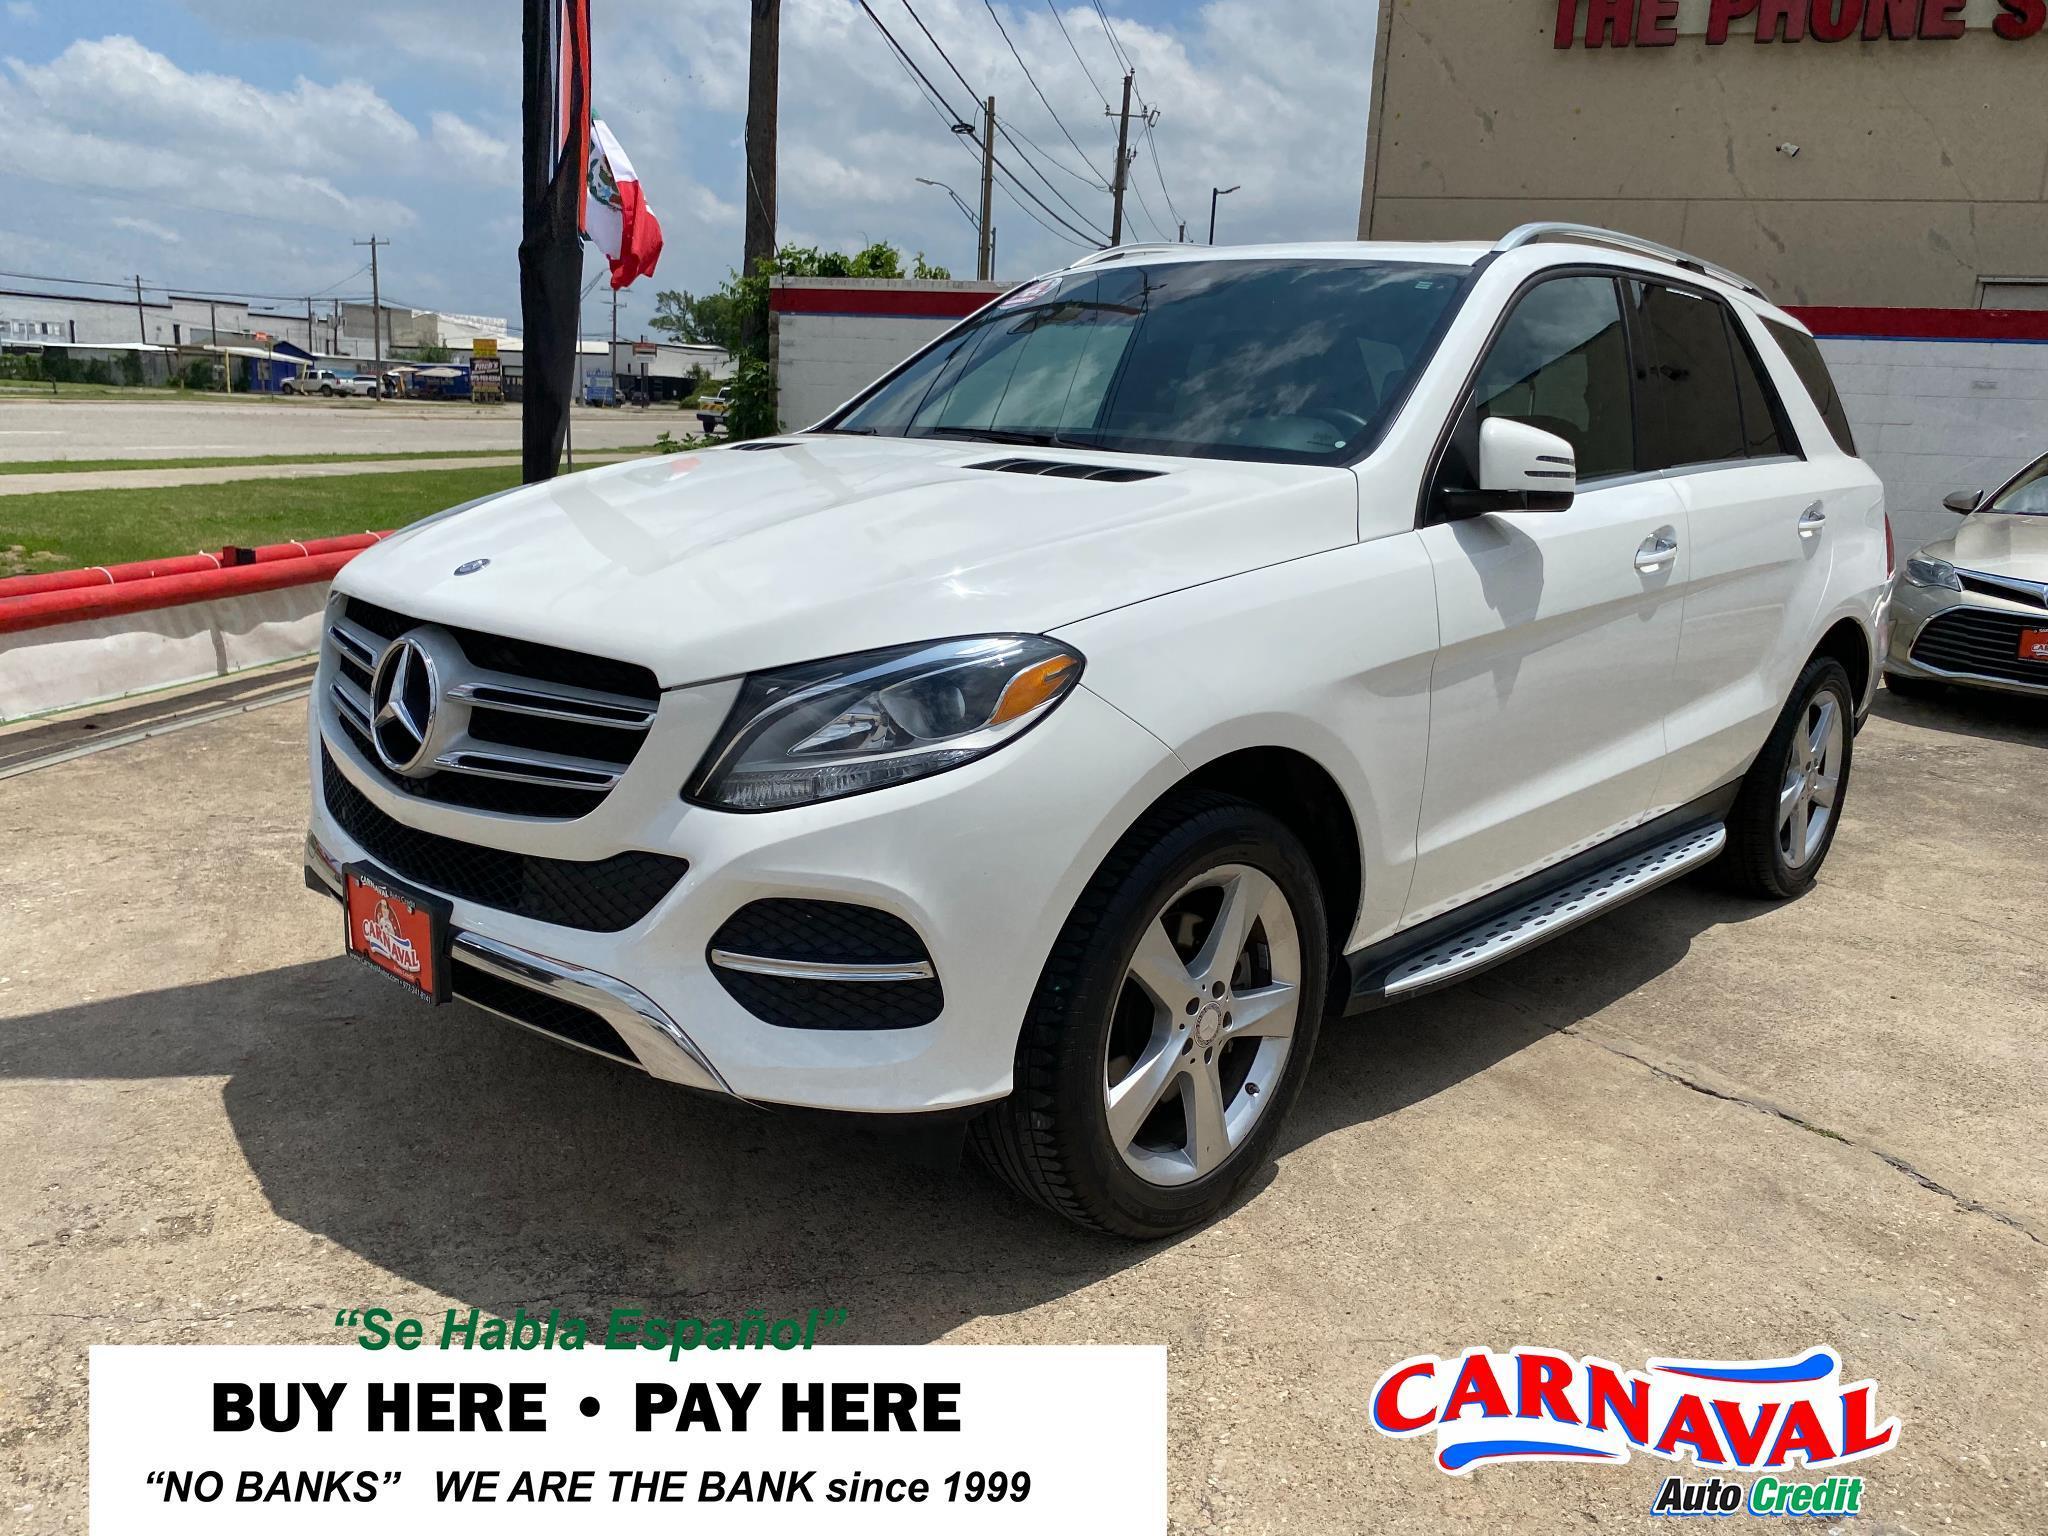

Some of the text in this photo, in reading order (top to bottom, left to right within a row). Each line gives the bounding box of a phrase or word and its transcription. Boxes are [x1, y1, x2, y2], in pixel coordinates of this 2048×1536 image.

[1554, 0, 1679, 49] THE
[1705, 0, 1966, 45] PHONE
[363, 919, 420, 970] CARNAVAL
